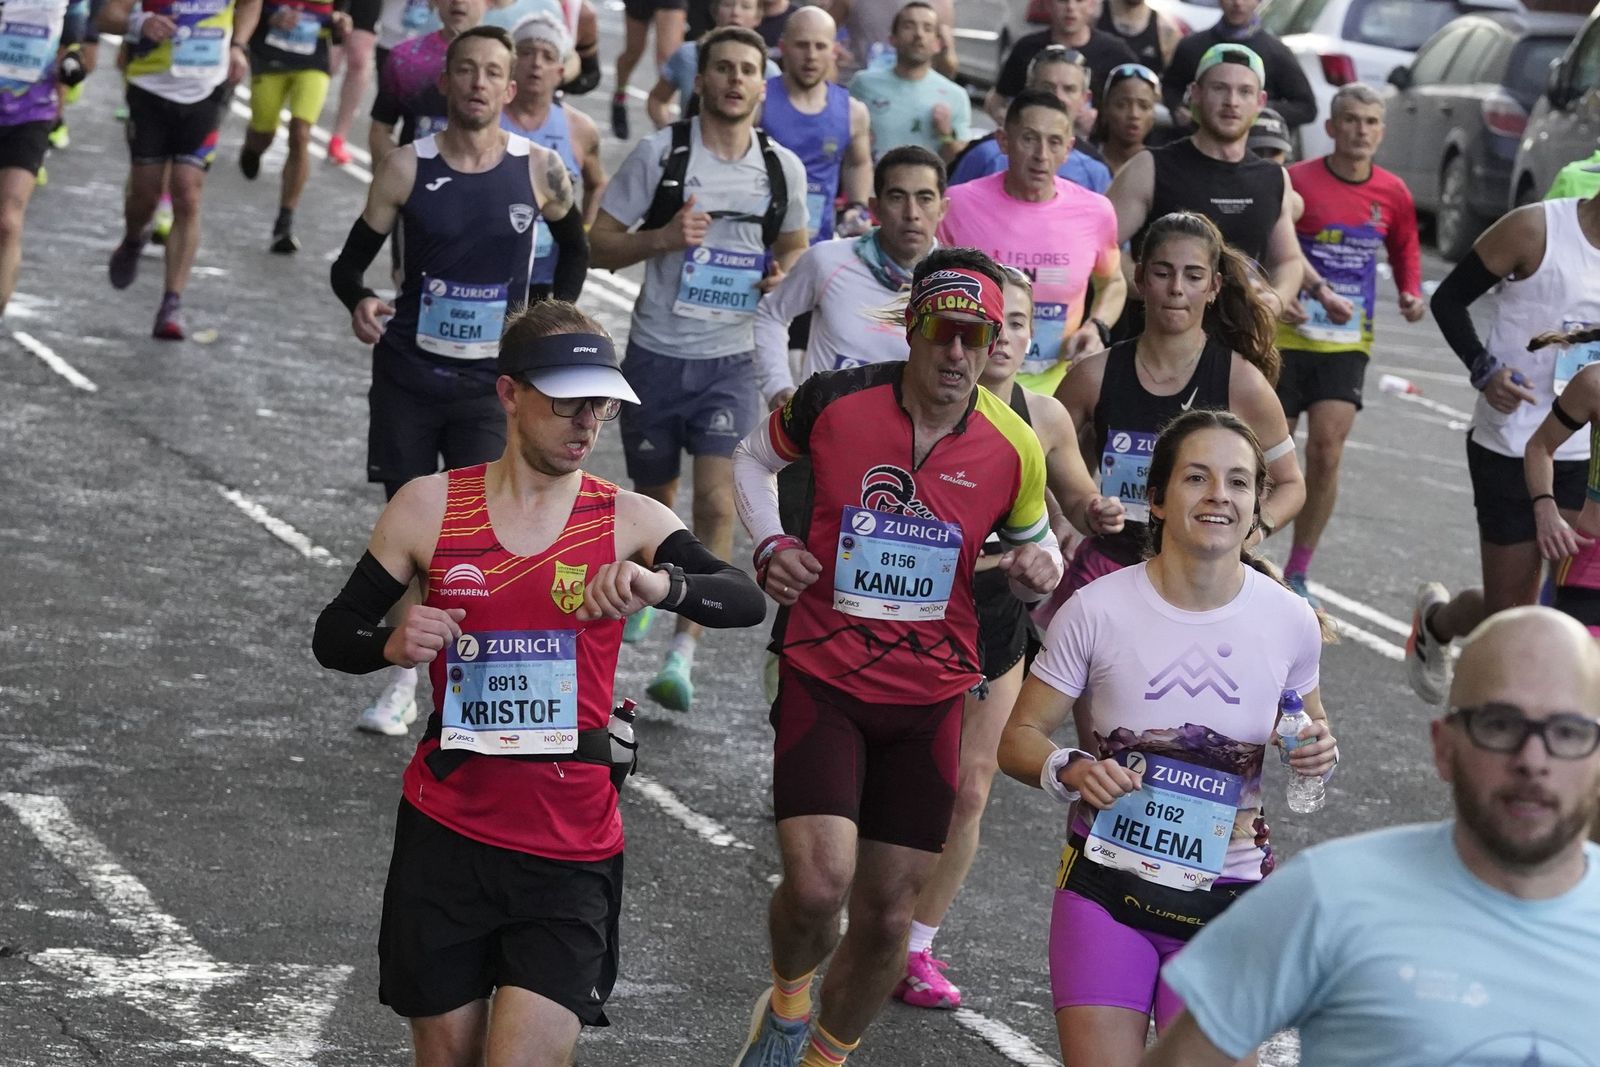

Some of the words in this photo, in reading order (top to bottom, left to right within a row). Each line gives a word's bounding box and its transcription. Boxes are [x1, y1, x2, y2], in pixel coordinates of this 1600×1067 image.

[714, 253, 756, 267] ZURICH
[451, 286, 499, 299] ZURICH
[688, 287, 750, 308] PIERROT
[439, 321, 483, 339] CLEM
[883, 520, 950, 543] ZURICH
[880, 551, 917, 569] 8156
[440, 588, 490, 597] SPORTARENA
[854, 569, 934, 598] KANIJO
[486, 638, 561, 655] ZURICH
[488, 675, 528, 692] 8913
[460, 699, 562, 725] KRISTOF
[1152, 765, 1228, 797] ZURICH
[1145, 801, 1186, 824] 6162
[1111, 814, 1204, 864] HELENA
